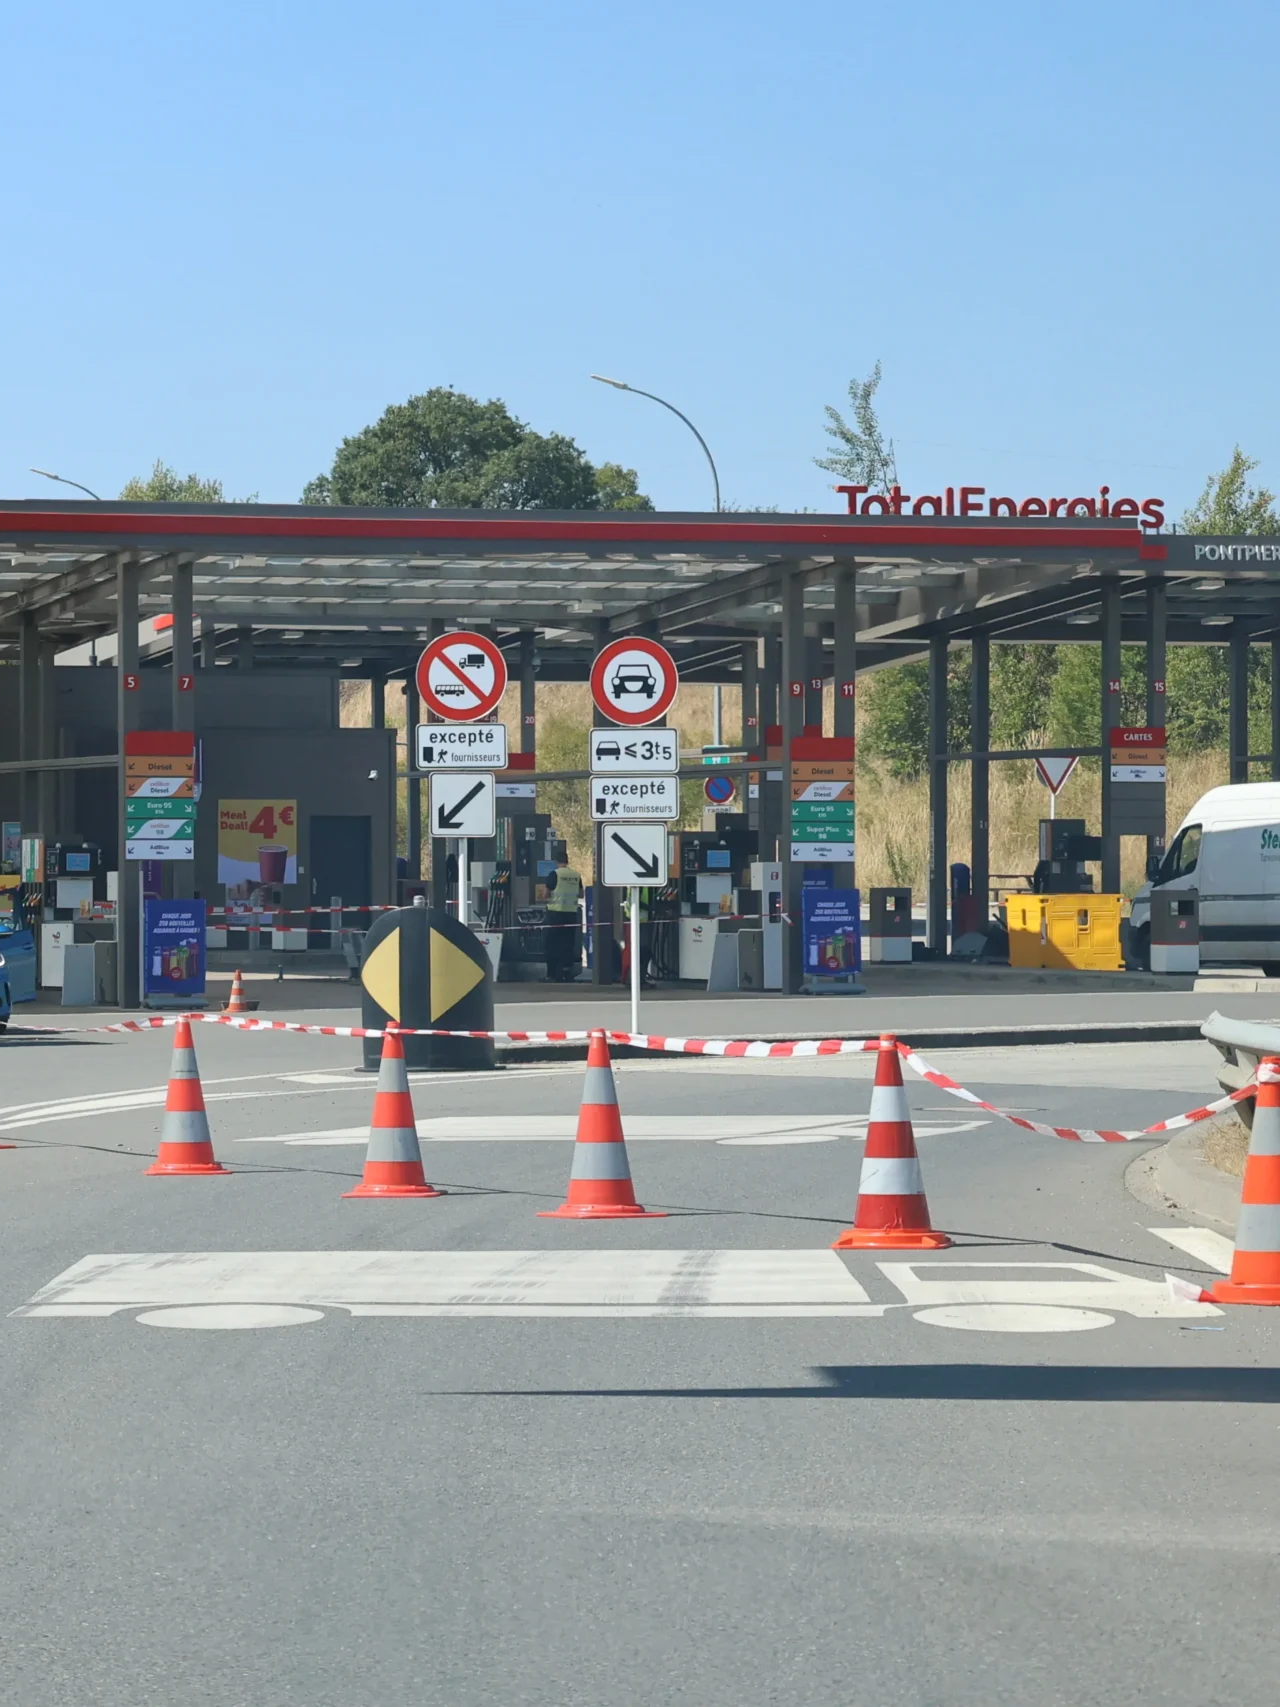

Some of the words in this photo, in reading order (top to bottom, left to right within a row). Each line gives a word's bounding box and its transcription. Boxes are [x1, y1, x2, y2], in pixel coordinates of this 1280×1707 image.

[127, 677, 135, 688] 5
[182, 678, 190, 689] 7
[811, 679, 822, 689] 13
[1109, 681, 1120, 691] 14
[1154, 682, 1164, 692] 15
[793, 683, 800, 695] 9
[842, 684, 854, 696] 11
[525, 716, 535, 724] 20
[747, 717, 756, 726] 21
[429, 729, 494, 747] excepté
[1123, 733, 1153, 741] CARTES
[451, 752, 501, 762] fournisseurs
[148, 763, 172, 771] Diesel
[602, 780, 666, 799] excepté
[623, 804, 673, 814] fournisseurs
[220, 810, 247, 820] Meal
[220, 821, 248, 831] Deal!
[806, 826, 824, 834] Super
[1260, 828, 1280, 850] Ste
